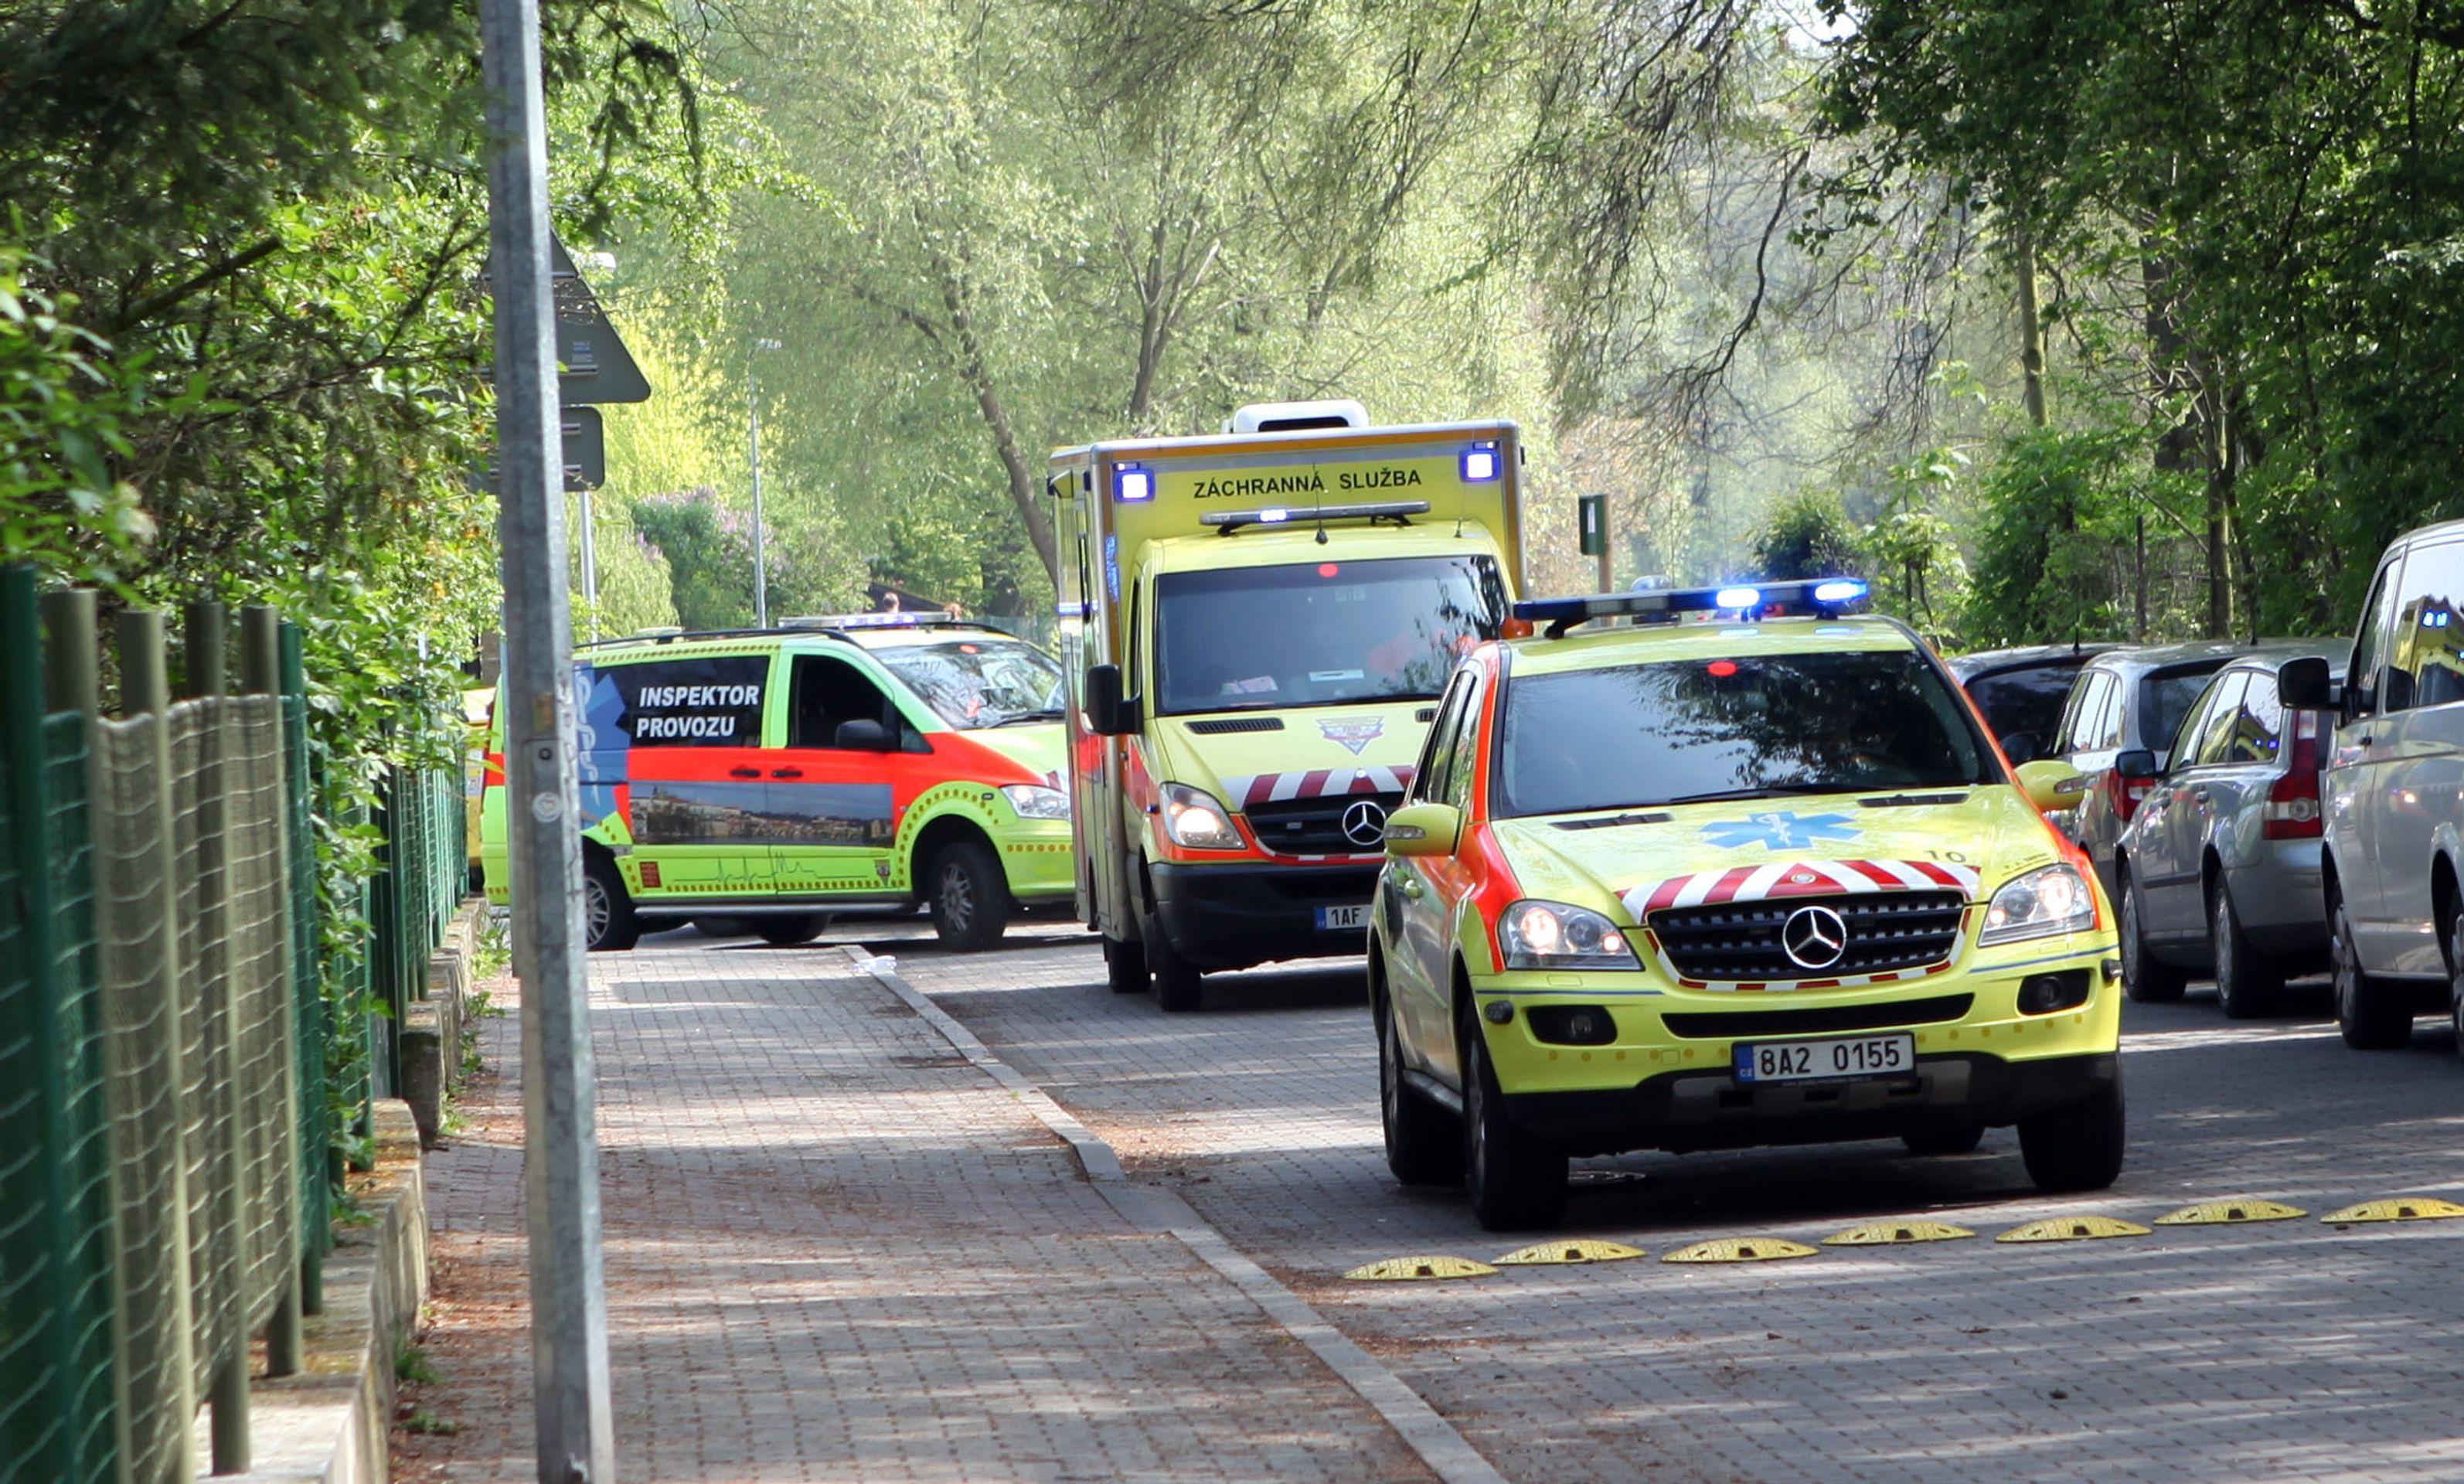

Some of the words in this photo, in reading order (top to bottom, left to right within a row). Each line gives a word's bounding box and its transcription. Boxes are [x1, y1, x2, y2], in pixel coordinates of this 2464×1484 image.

[1193, 471, 1324, 499] ZÁCHRANNÁ
[1339, 467, 1421, 490] SLUŽBA
[639, 685, 760, 707] INSPEKTOR
[636, 716, 735, 738] PROVOZU
[1925, 849, 1966, 863] 10
[1331, 907, 1361, 926] 1AF
[1761, 1047, 1811, 1075] 8A2
[1833, 1040, 1899, 1070] 0155
